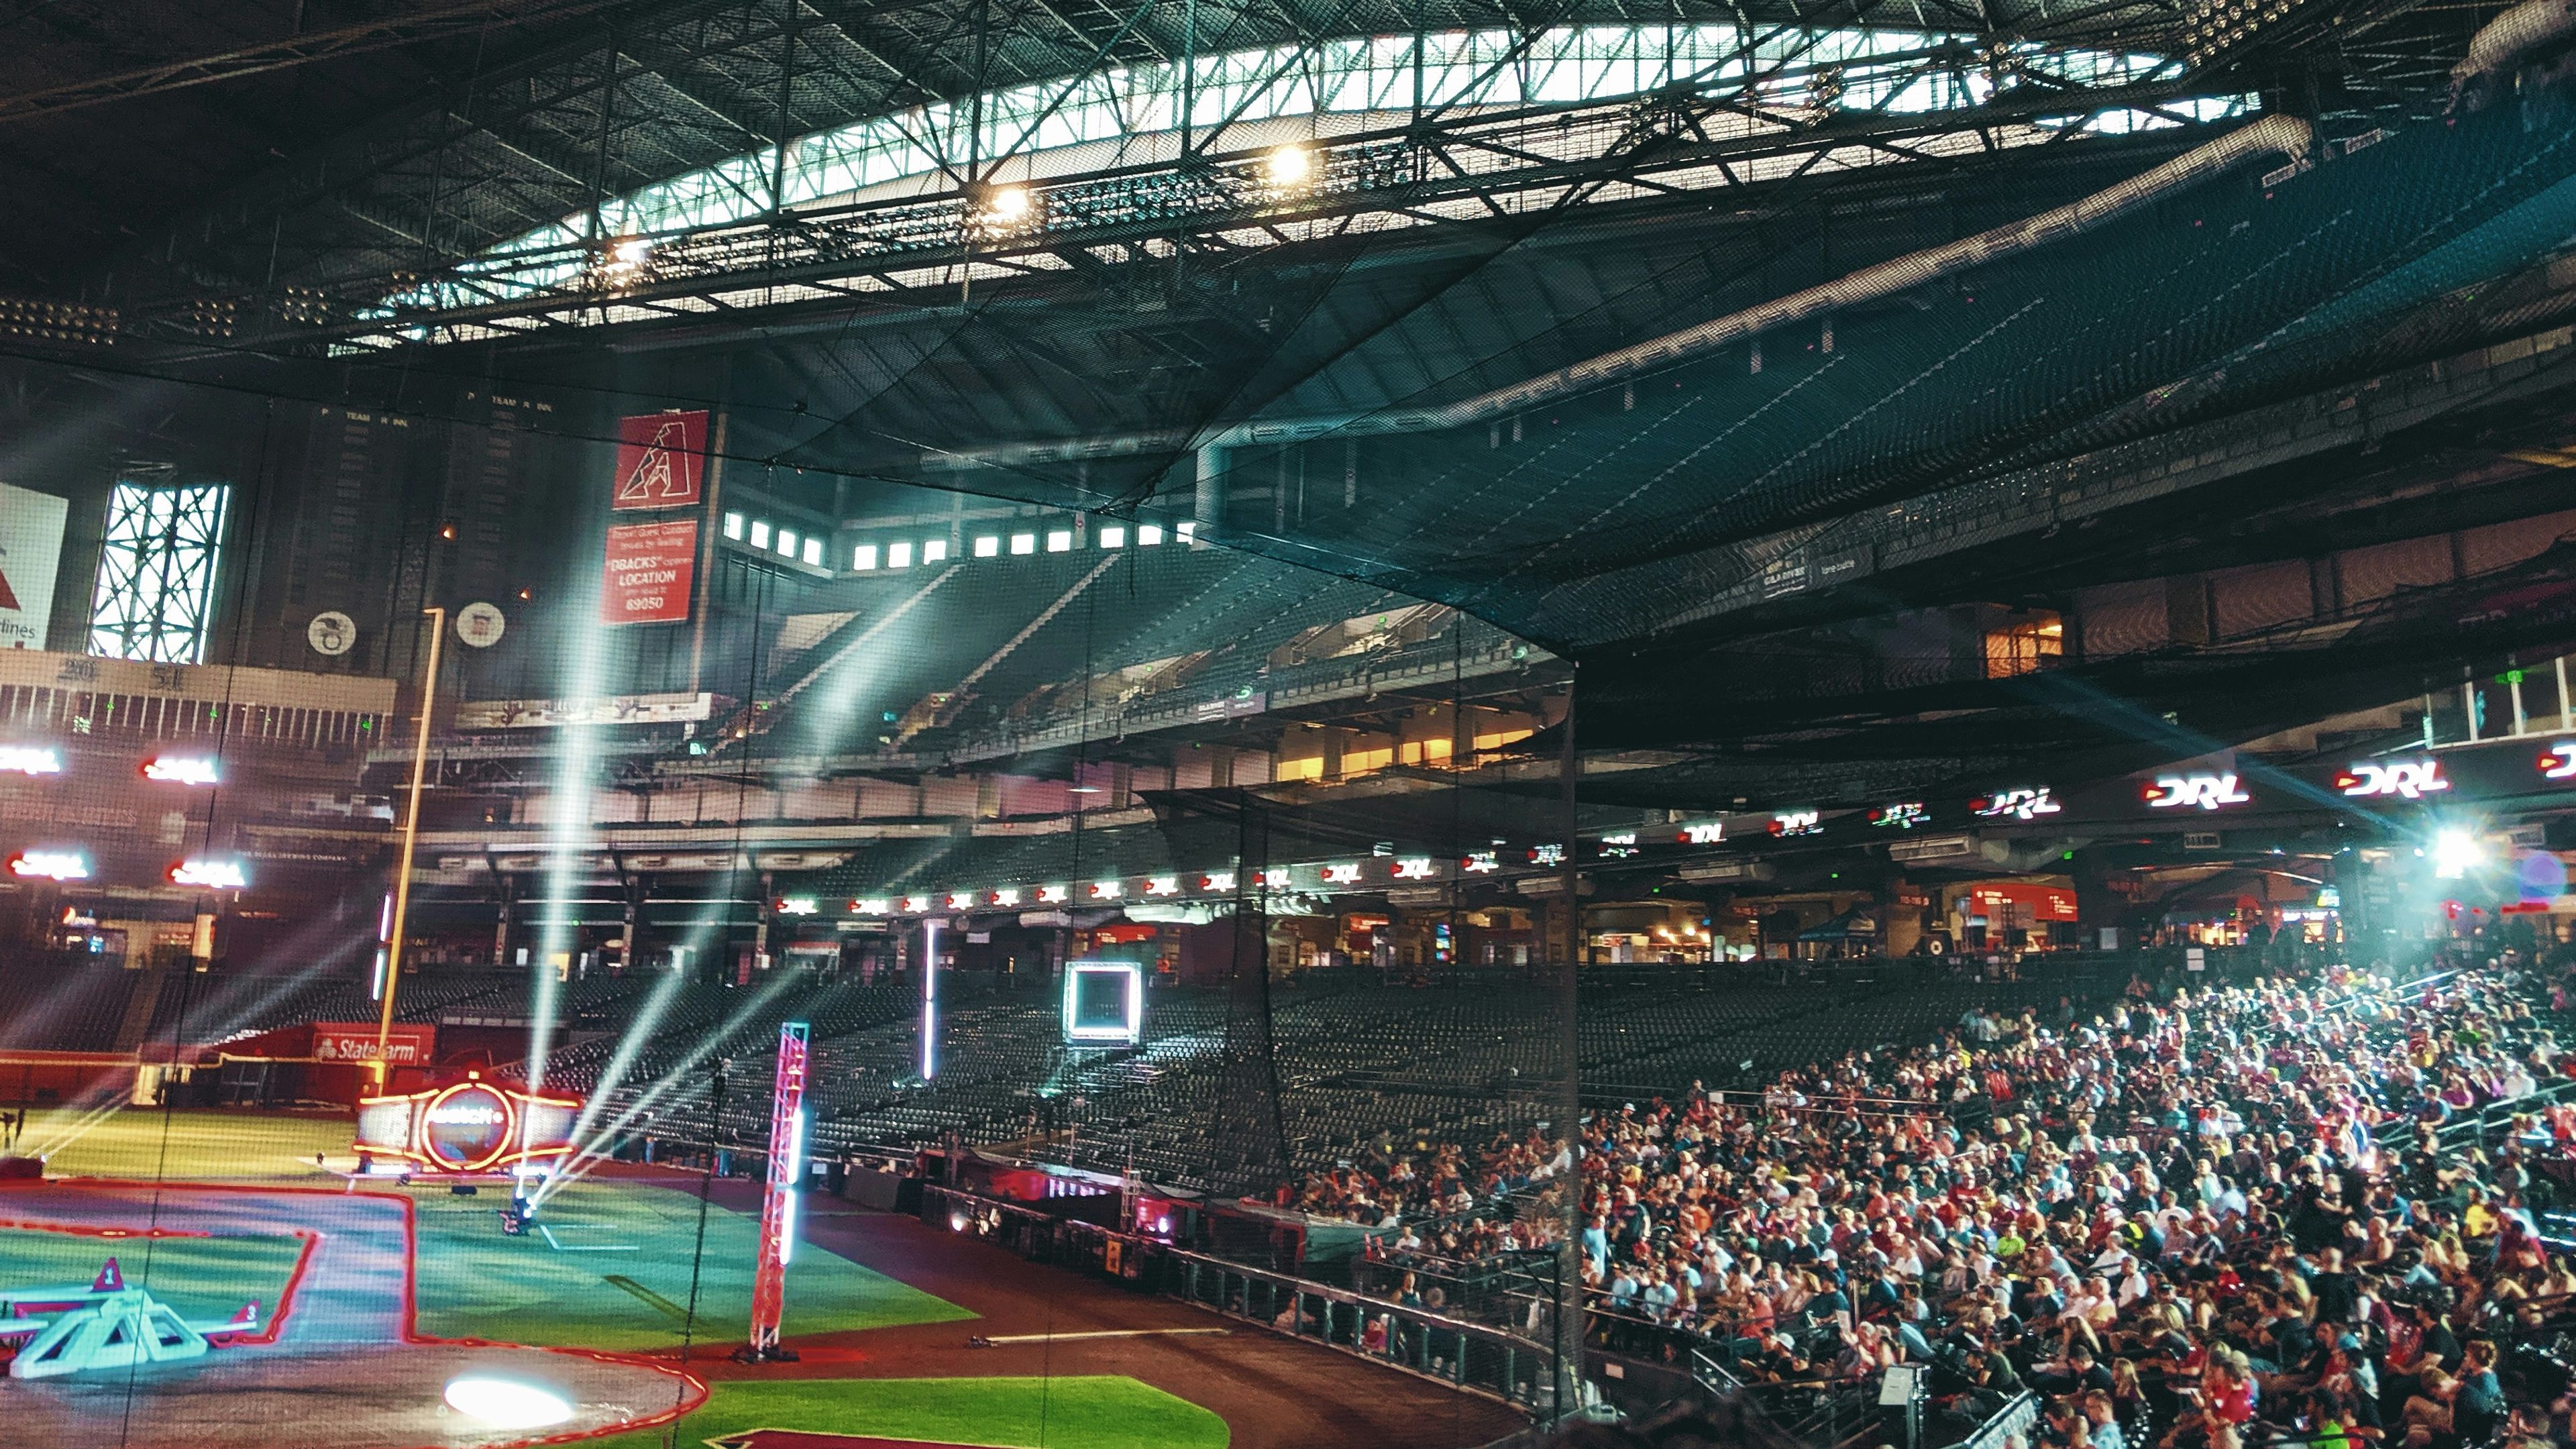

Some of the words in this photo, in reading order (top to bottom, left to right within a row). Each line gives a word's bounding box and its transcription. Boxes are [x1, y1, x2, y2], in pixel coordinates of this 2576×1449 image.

[492, 396, 517, 407] TEAM
[346, 412, 370, 422] TEAM
[619, 570, 676, 586] LOCATION
[626, 597, 663, 610] 69050
[0, 618, 36, 639] lines
[2339, 761, 2448, 798] DRL
[2146, 775, 2250, 810] DRL
[379, 1040, 415, 1061] arm
[105, 1267, 115, 1285] 1
[247, 1305, 256, 1322] 3
